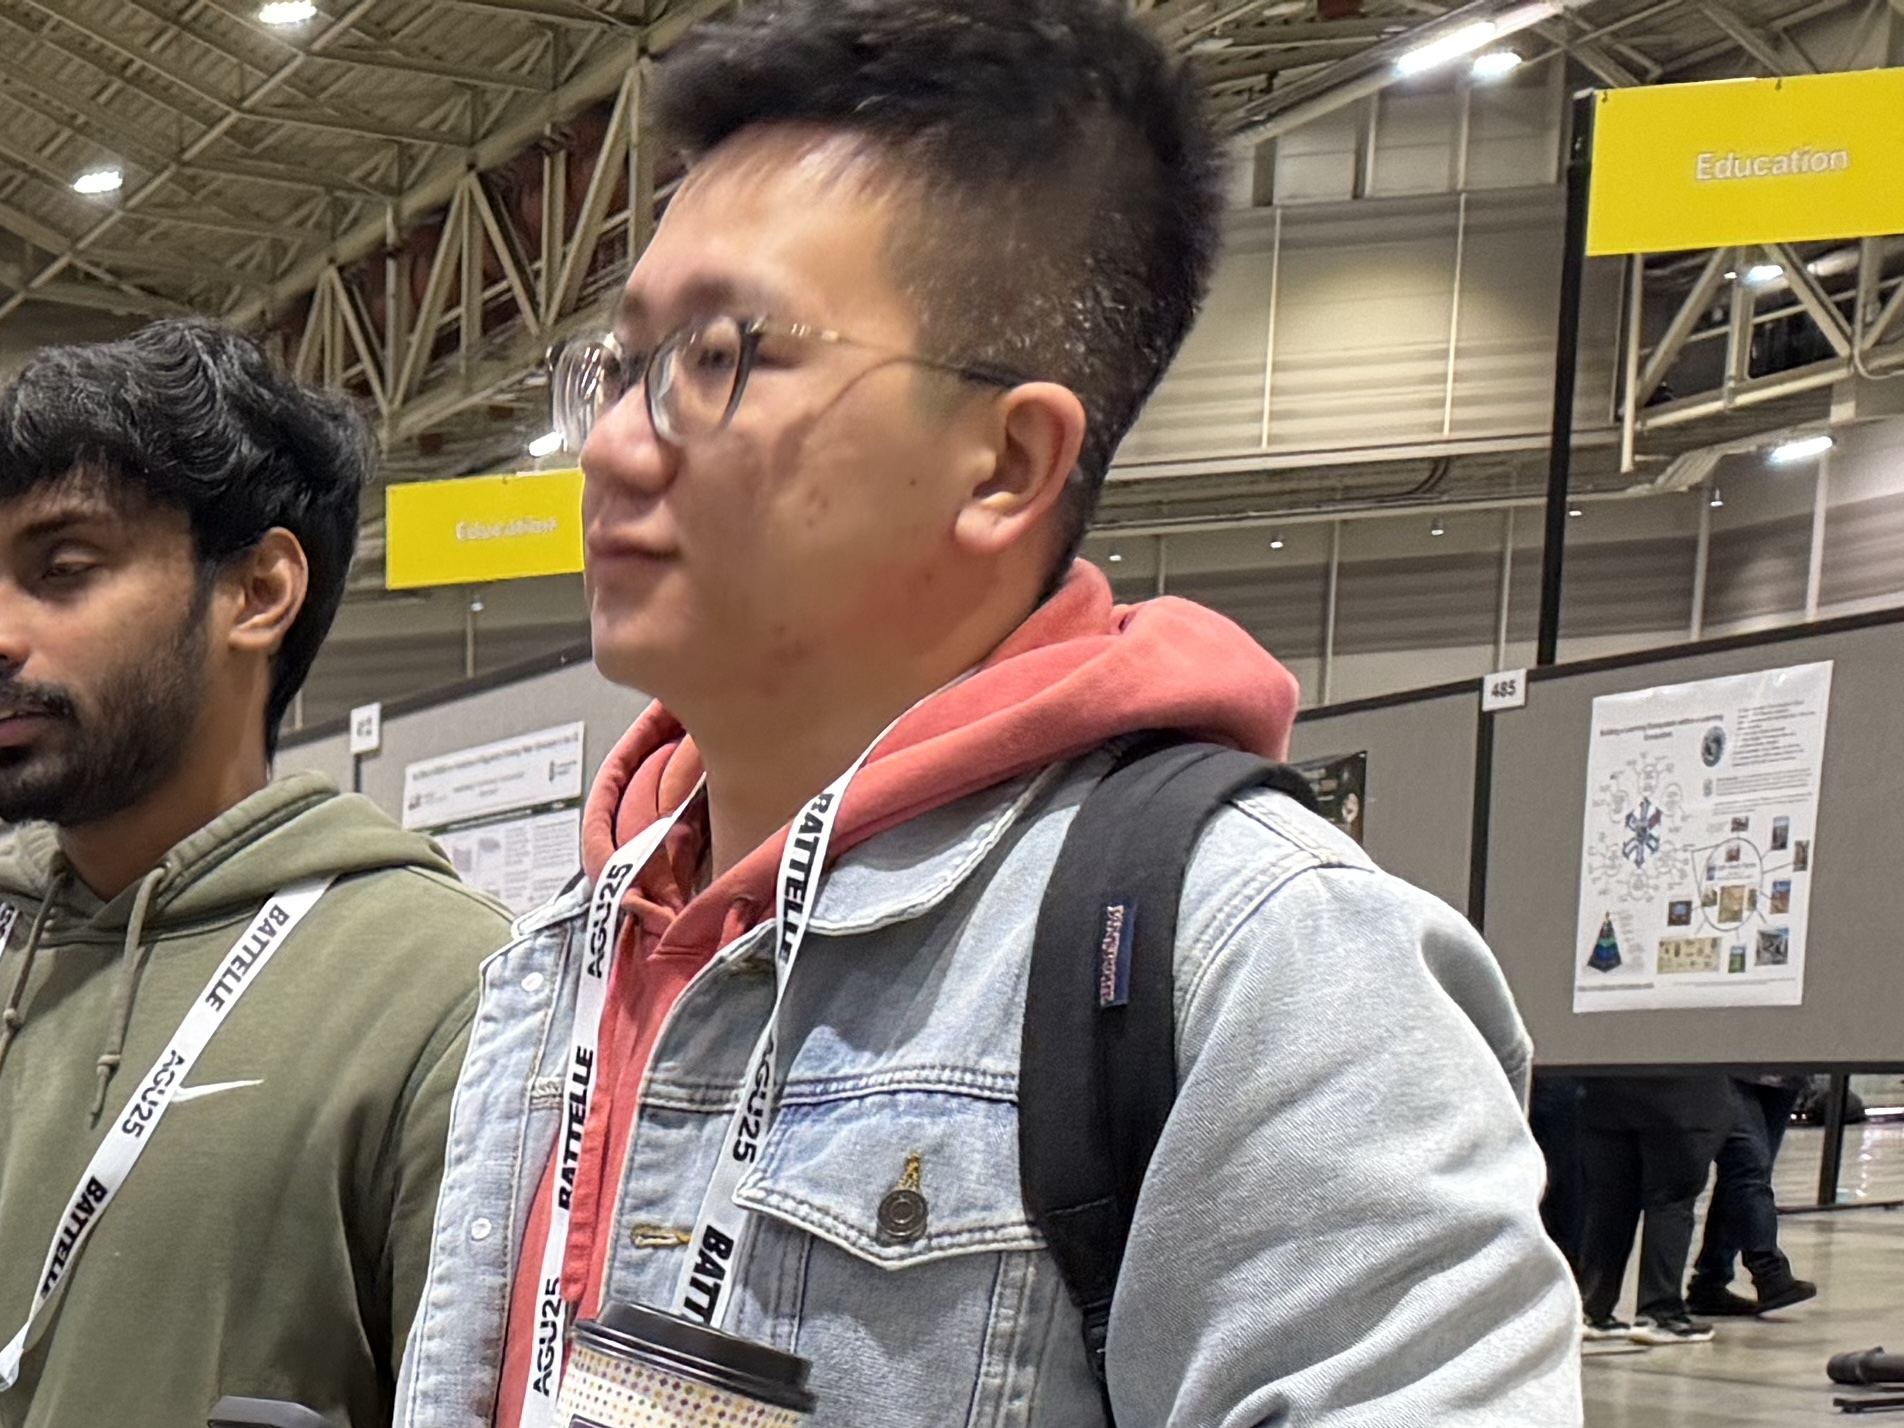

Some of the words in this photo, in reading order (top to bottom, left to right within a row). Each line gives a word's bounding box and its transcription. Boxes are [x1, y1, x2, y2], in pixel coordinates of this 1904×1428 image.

[1694, 145, 1850, 182] Education
[1491, 679, 1516, 697] 485
[205, 903, 291, 1012] BATTELLE
[588, 862, 633, 978] AGU25
[121, 1049, 185, 1138] AGU25
[559, 1045, 595, 1211] BATTELLE
[532, 1278, 562, 1397] AGU25
